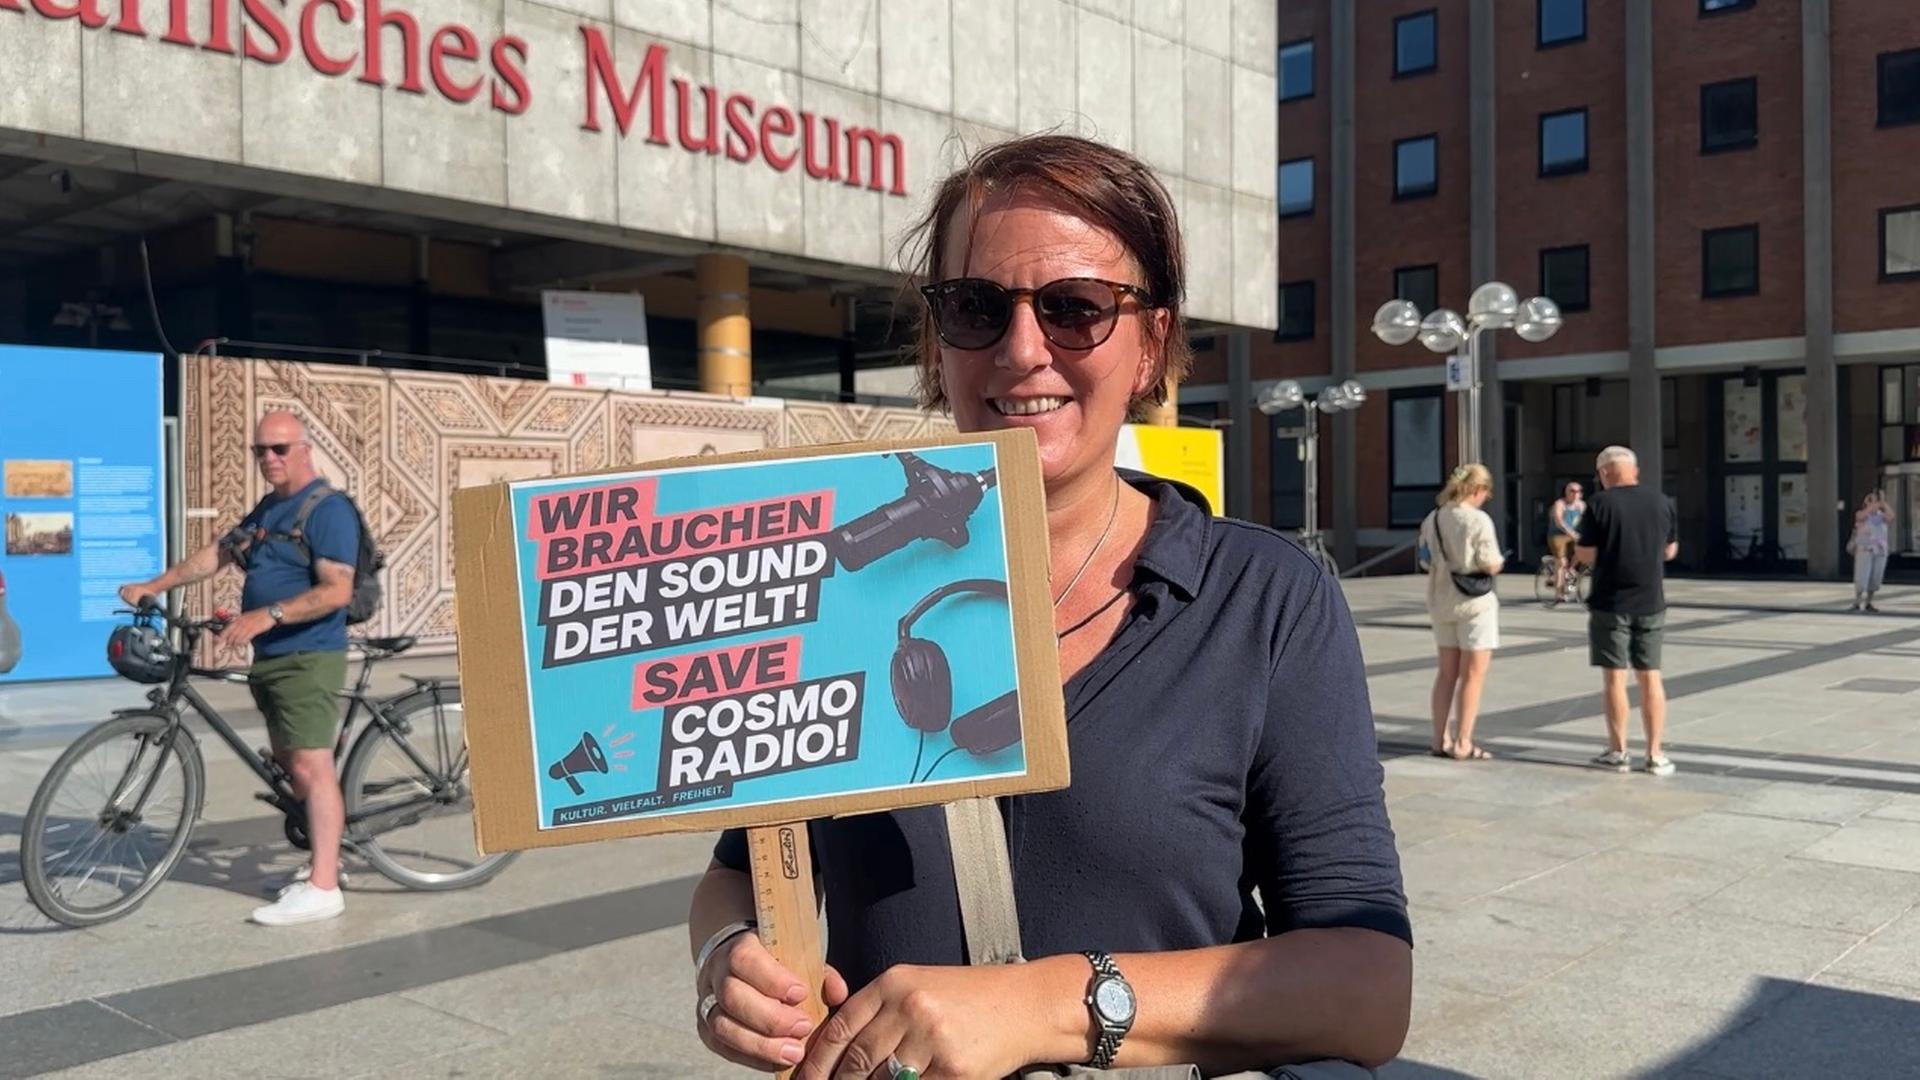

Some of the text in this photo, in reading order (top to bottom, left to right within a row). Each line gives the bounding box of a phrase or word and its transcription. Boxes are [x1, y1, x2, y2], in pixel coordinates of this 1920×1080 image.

[0, 0, 908, 197] isches Museum
[538, 486, 639, 534] WIR
[547, 496, 822, 573] BRAUCHEN
[549, 541, 828, 618] DEN SOUND
[554, 583, 808, 660] DER WELT!
[643, 642, 788, 703] SAVE
[671, 680, 858, 743] COSMO
[669, 719, 850, 787] RADIO!
[560, 785, 726, 822] KULTUR. VIELFALT. FREIHEIT.
